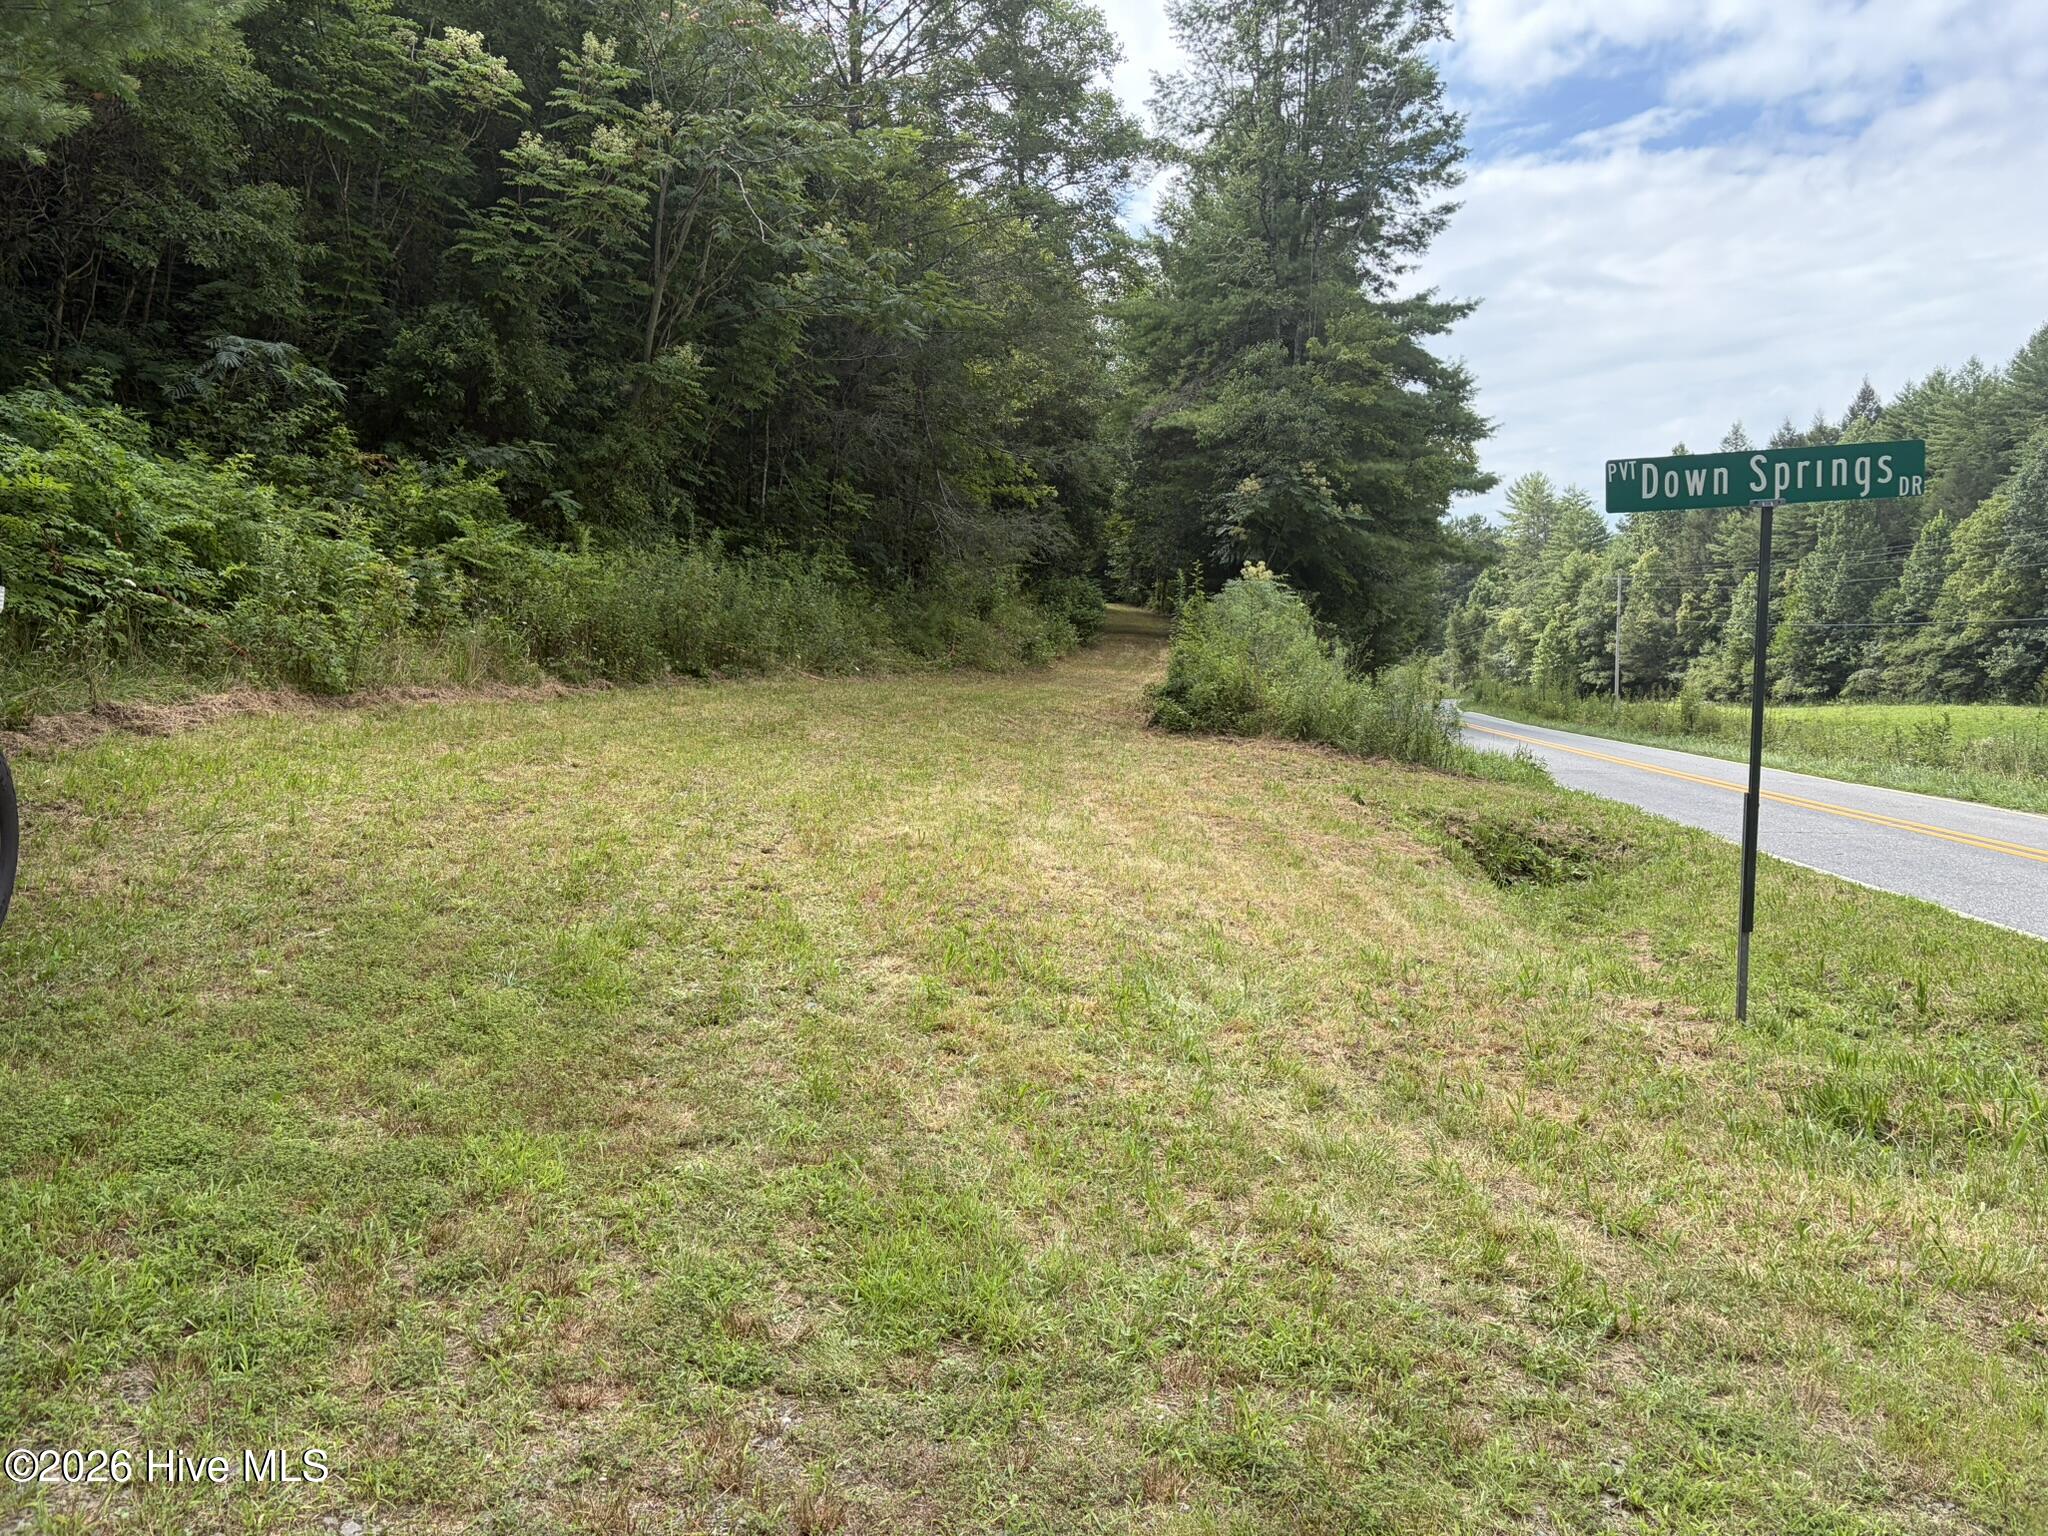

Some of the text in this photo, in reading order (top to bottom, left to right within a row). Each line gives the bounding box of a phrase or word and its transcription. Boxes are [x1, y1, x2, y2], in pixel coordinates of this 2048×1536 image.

[1607, 454, 1923, 500] PVT Down Springs DR
